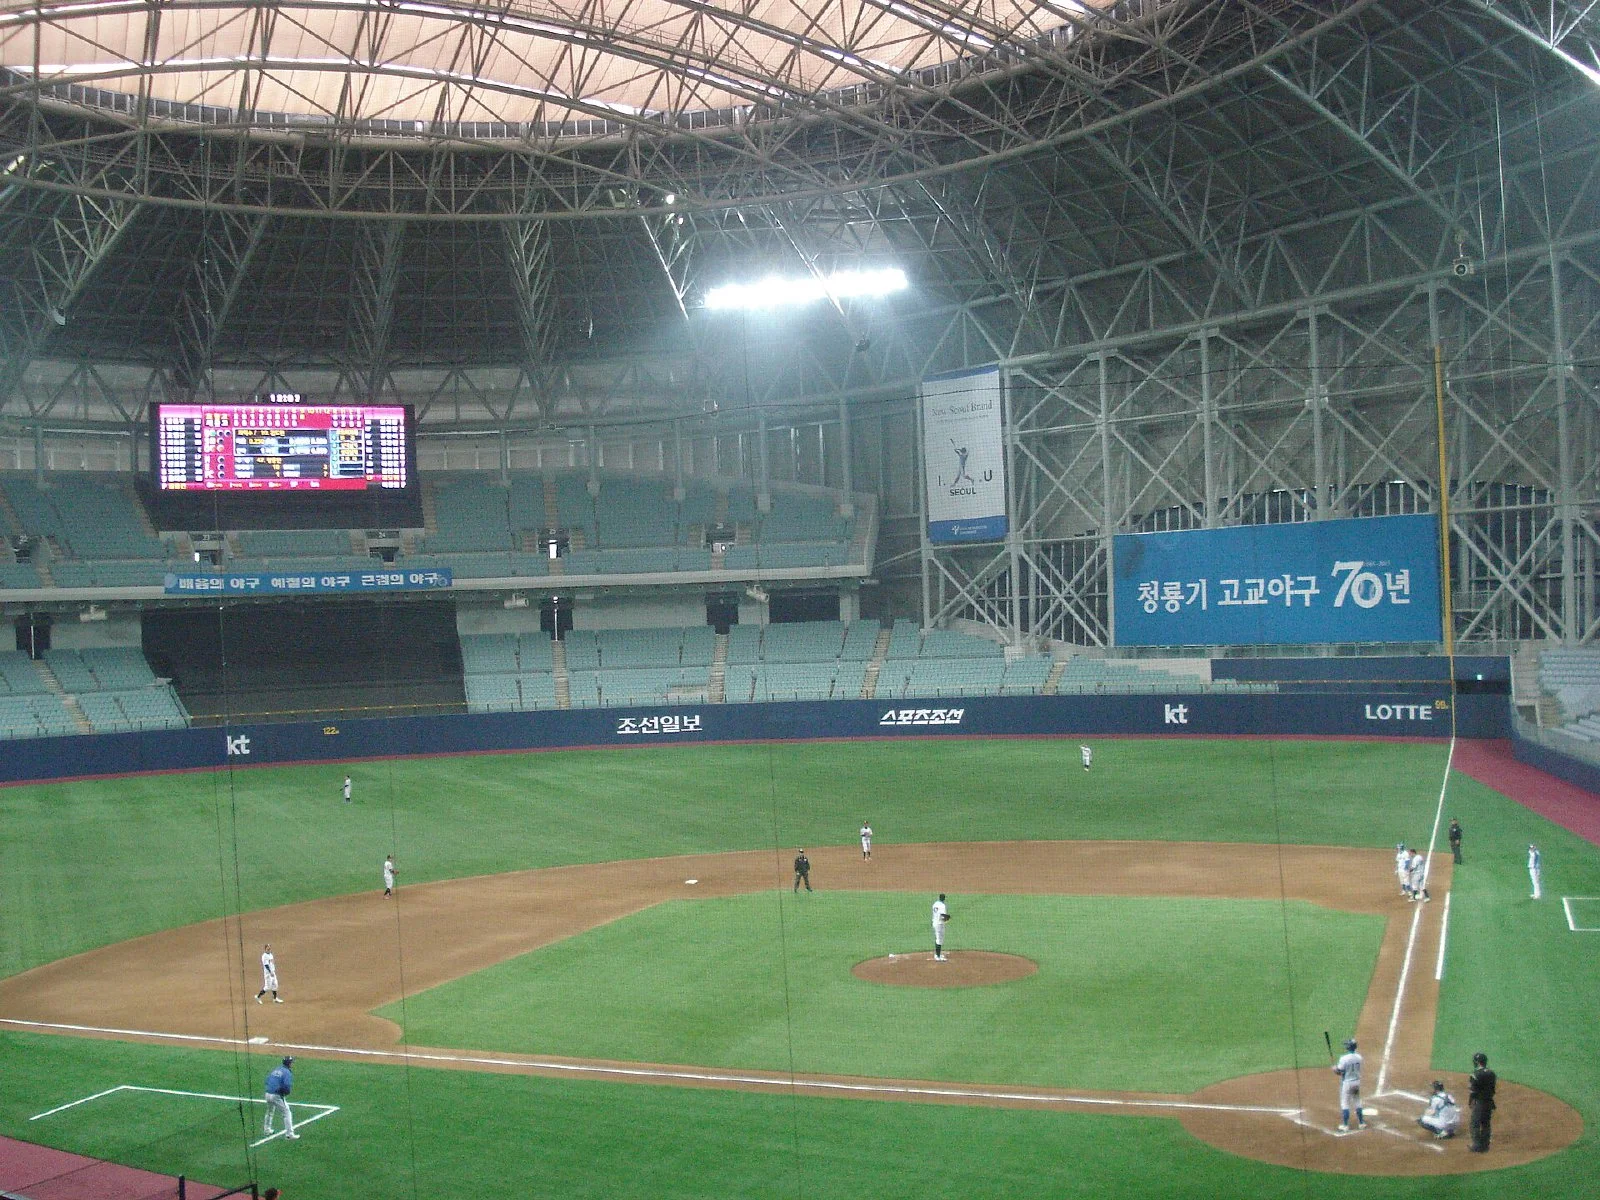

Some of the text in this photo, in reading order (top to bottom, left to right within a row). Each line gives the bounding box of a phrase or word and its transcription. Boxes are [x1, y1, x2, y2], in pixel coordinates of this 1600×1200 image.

[971, 400, 993, 412] Brand
[950, 487, 977, 497] SEOUL
[179, 578, 224, 590] 배움의
[230, 578, 260, 589] 야구
[321, 576, 351, 587] 야구
[409, 572, 439, 585] 야구
[1136, 578, 1208, 614] 청룡기
[1217, 574, 1320, 607] 고교야구
[879, 708, 965, 726] 스포츠조선
[1164, 703, 1188, 724] kt
[1364, 704, 1432, 721] LOTTE
[616, 714, 703, 735] 조선일보
[226, 734, 251, 756] kt
